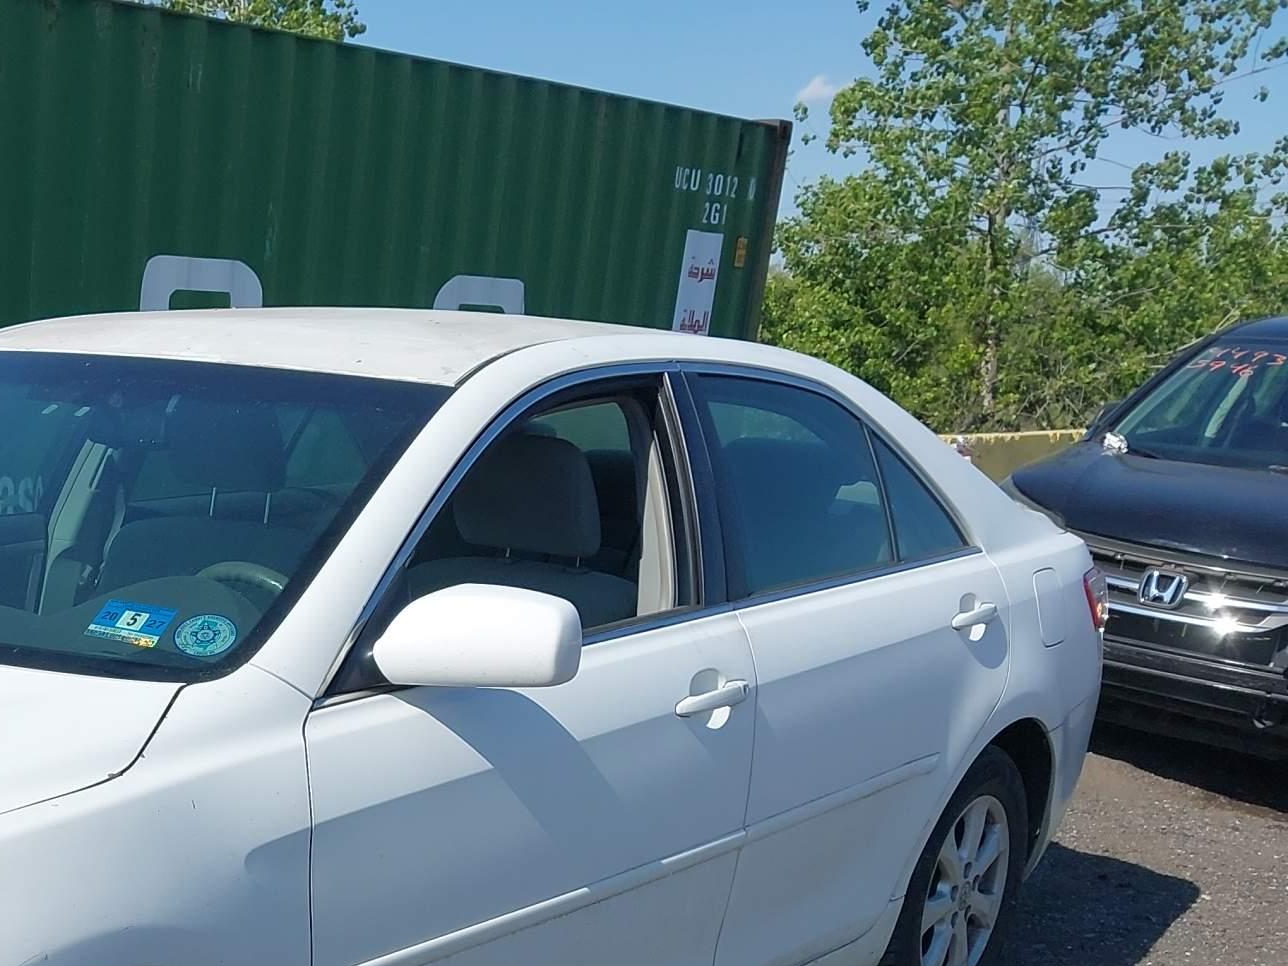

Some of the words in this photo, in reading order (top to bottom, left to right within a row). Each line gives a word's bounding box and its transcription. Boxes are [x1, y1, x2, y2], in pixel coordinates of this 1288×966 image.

[101, 610, 119, 621] 20
[126, 612, 142, 627] 5
[145, 619, 166, 630] 27
